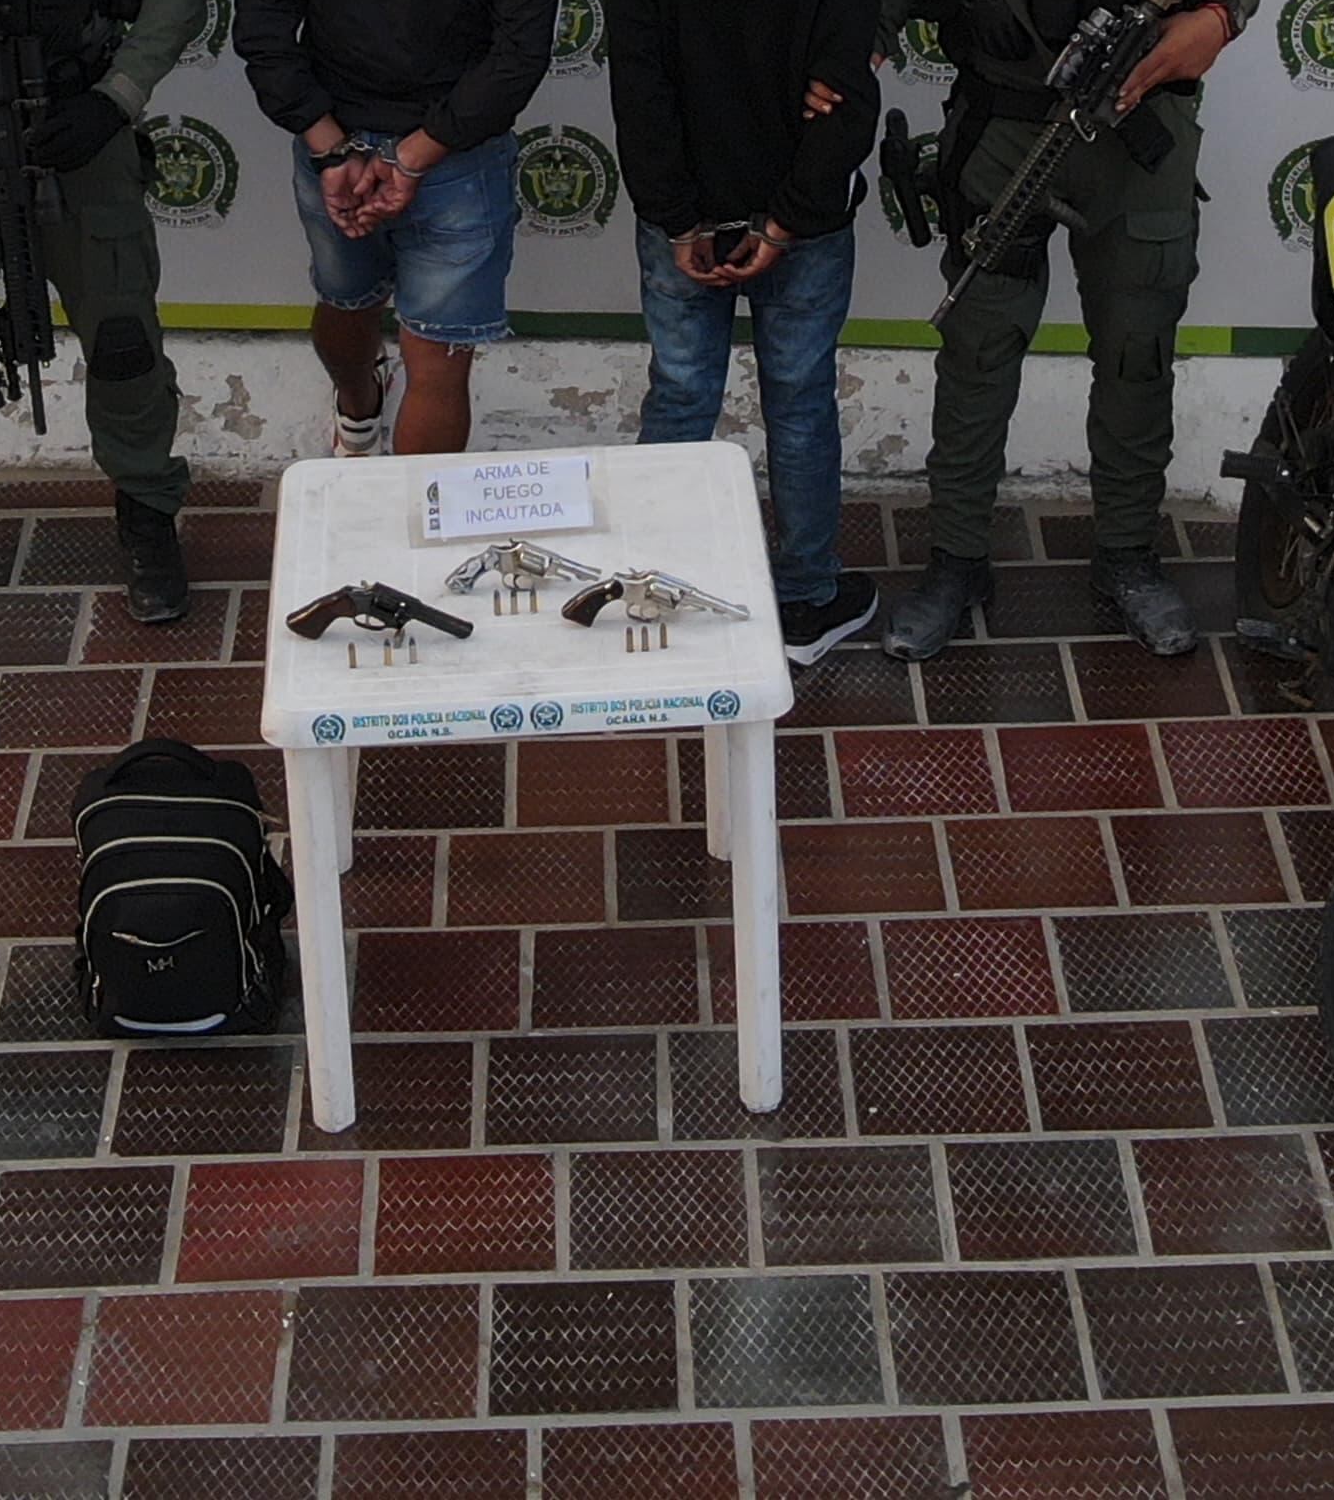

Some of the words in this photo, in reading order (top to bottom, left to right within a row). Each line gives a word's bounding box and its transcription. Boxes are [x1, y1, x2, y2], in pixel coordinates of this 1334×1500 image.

[473, 463, 523, 481] ARMA
[526, 461, 550, 476] DE
[483, 483, 543, 500] FUEGO
[466, 502, 564, 524] INCAUTADA
